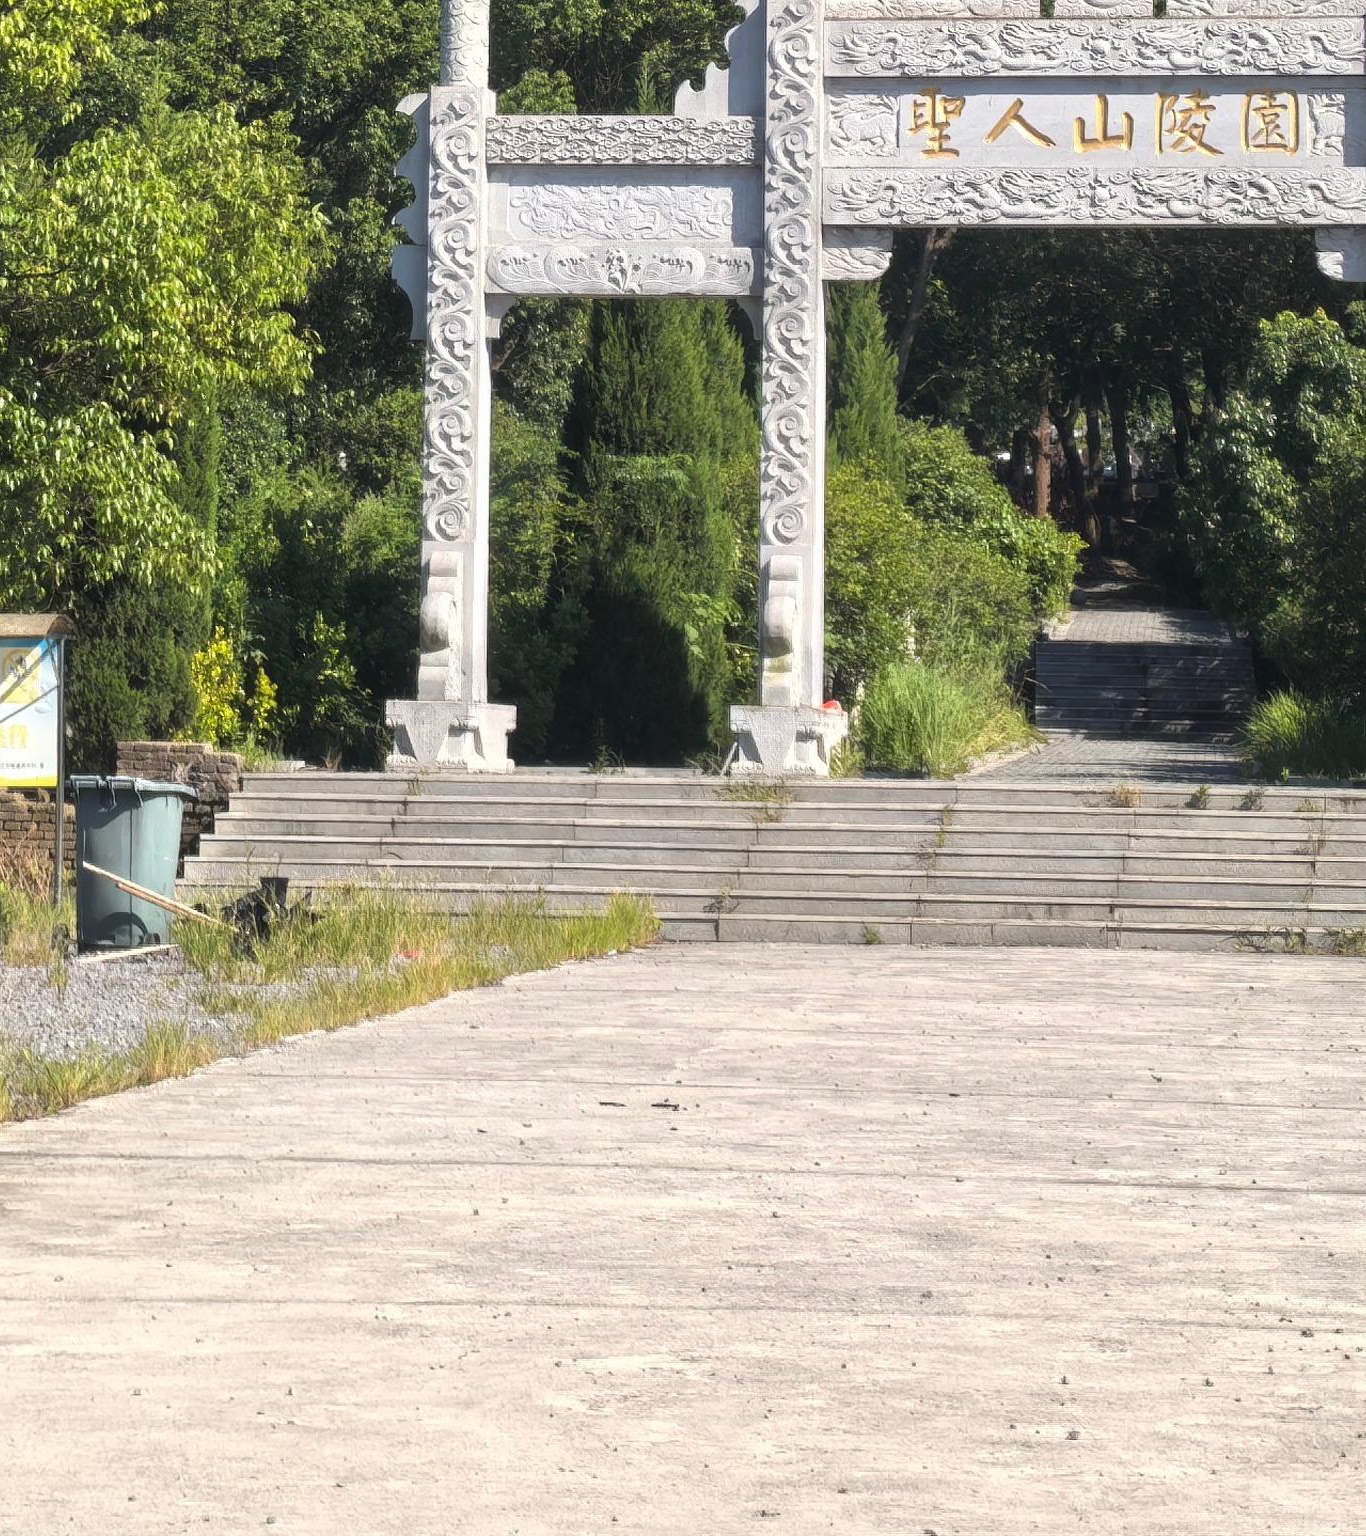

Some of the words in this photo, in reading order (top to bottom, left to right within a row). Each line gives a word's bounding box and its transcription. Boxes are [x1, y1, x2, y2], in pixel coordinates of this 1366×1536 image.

[907, 88, 1300, 159] 聖人山陵園
